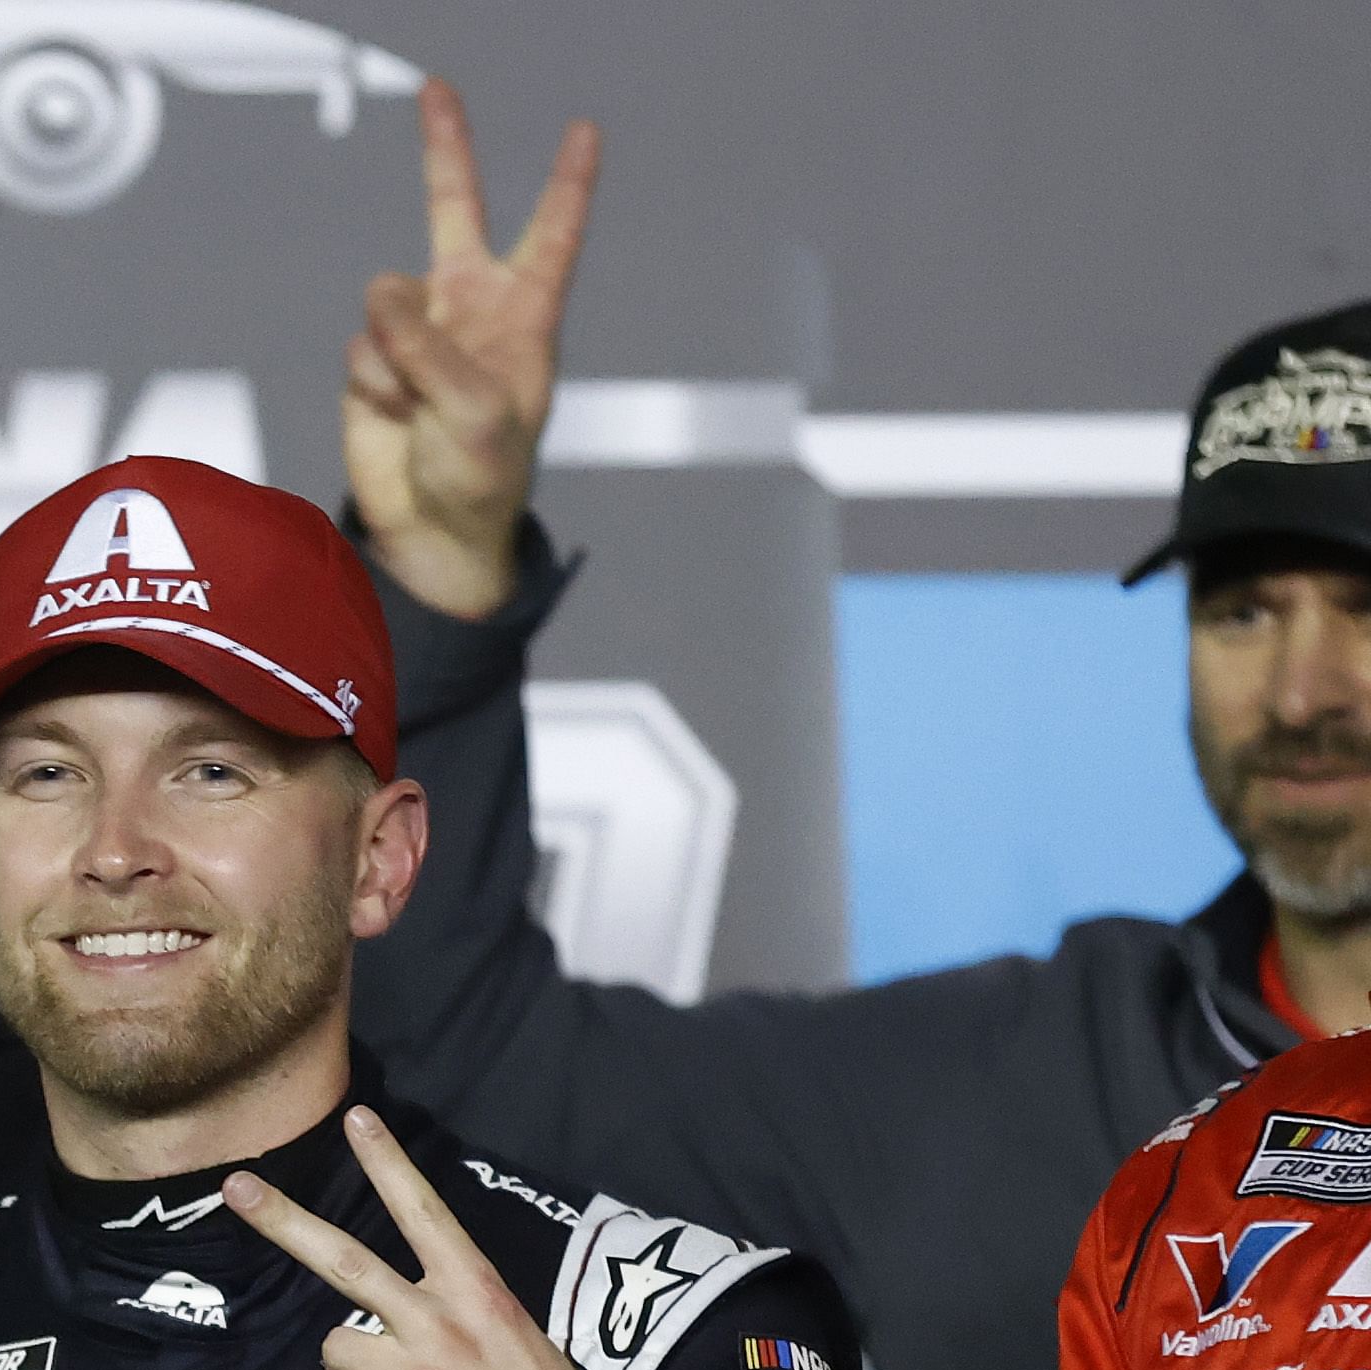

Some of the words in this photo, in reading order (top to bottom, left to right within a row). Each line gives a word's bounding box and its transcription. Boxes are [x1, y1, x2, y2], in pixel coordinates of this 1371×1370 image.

[28, 577, 210, 628] AXALTA
[1271, 1159, 1322, 1178] CUP
[1307, 1303, 1371, 1332] AX
